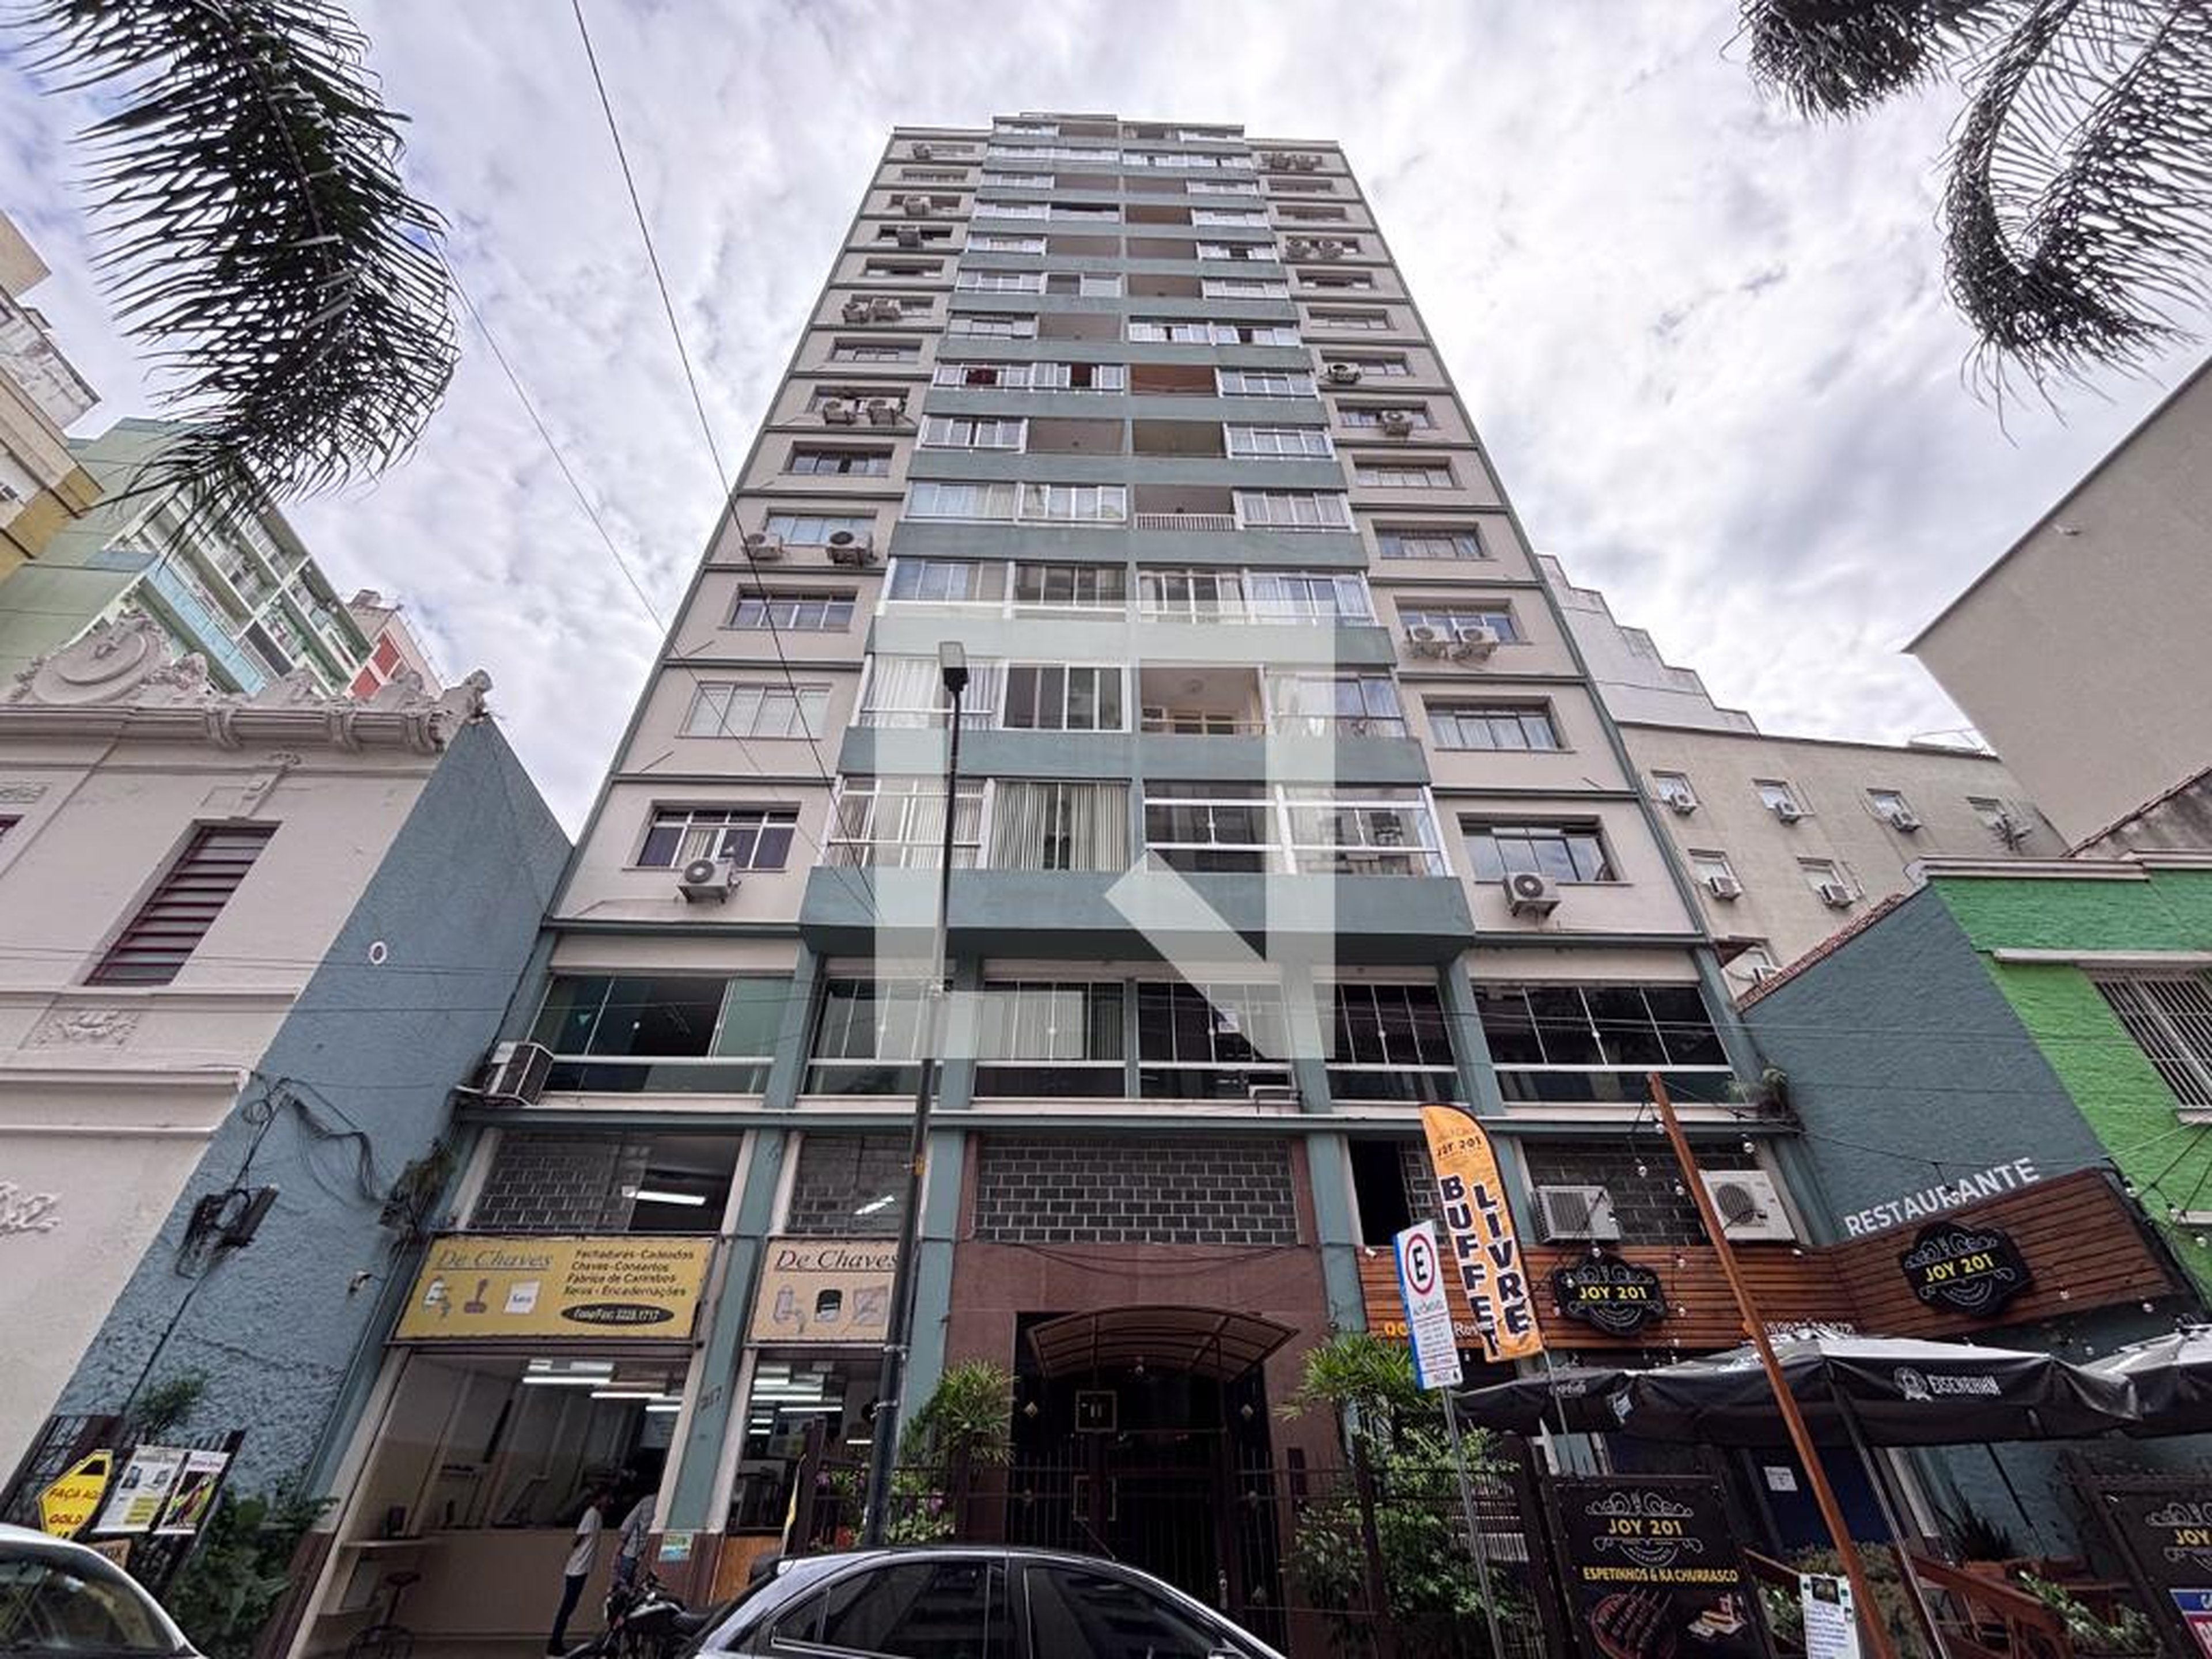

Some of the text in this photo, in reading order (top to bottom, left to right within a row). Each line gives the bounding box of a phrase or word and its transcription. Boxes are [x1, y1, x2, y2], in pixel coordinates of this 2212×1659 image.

[1844, 1157, 2040, 1237] RESTAURANTE
[438, 1249, 554, 1266] De Chaves
[777, 1249, 900, 1268] De Chaves
[1412, 1245, 1427, 1282] E
[1440, 1175, 1498, 1357] BUFFET
[1473, 1183, 1532, 1335] LIVRE
[1925, 1252, 1995, 1283] JOY 201
[1579, 1286, 1647, 1300] JOY 201
[1608, 1518, 1684, 1536] JOY 201
[2174, 1528, 2211, 1546] JOY
[1584, 1566, 1649, 1582] ESPETINHOS
[1675, 1568, 1739, 1583] CHURRASCO
